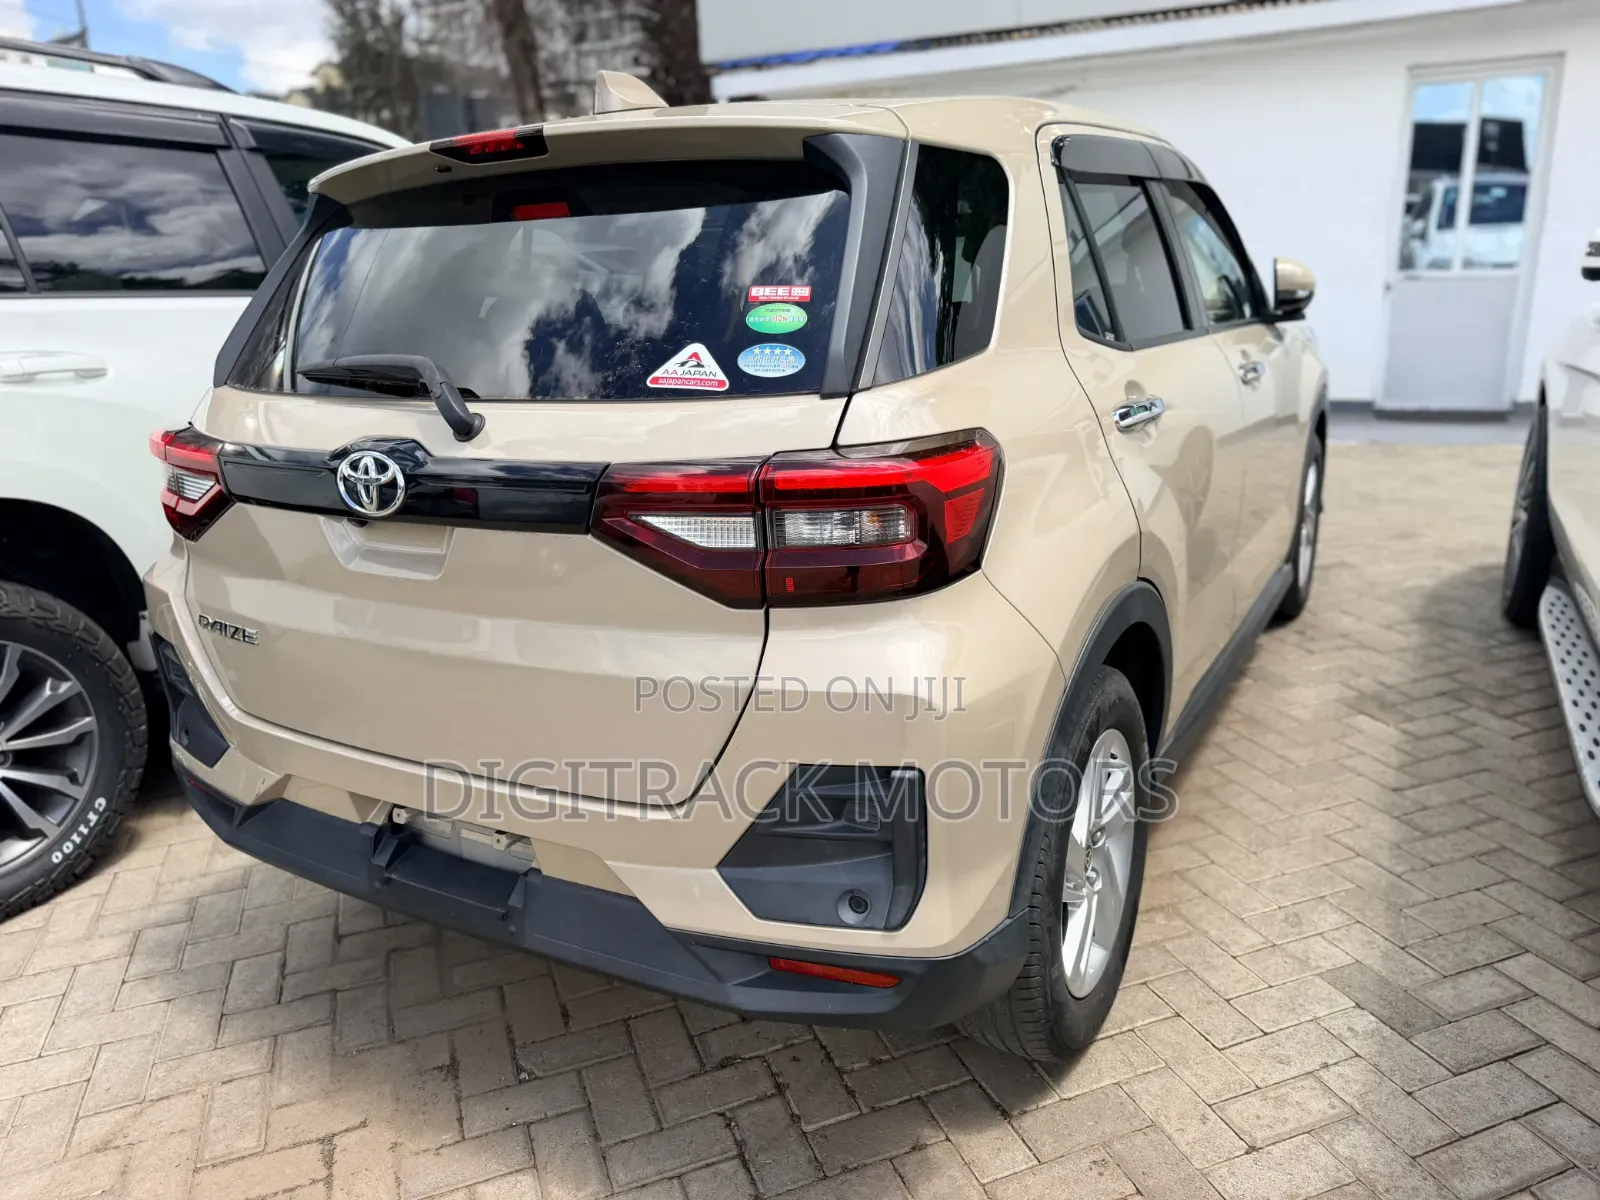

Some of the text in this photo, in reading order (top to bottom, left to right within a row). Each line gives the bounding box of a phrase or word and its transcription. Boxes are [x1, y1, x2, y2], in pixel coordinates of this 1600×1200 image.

[751, 287, 790, 296] BEE
[661, 368, 717, 378] AA JAPAN
[657, 377, 718, 387] aajapancars.com
[199, 613, 259, 646] RAIZE
